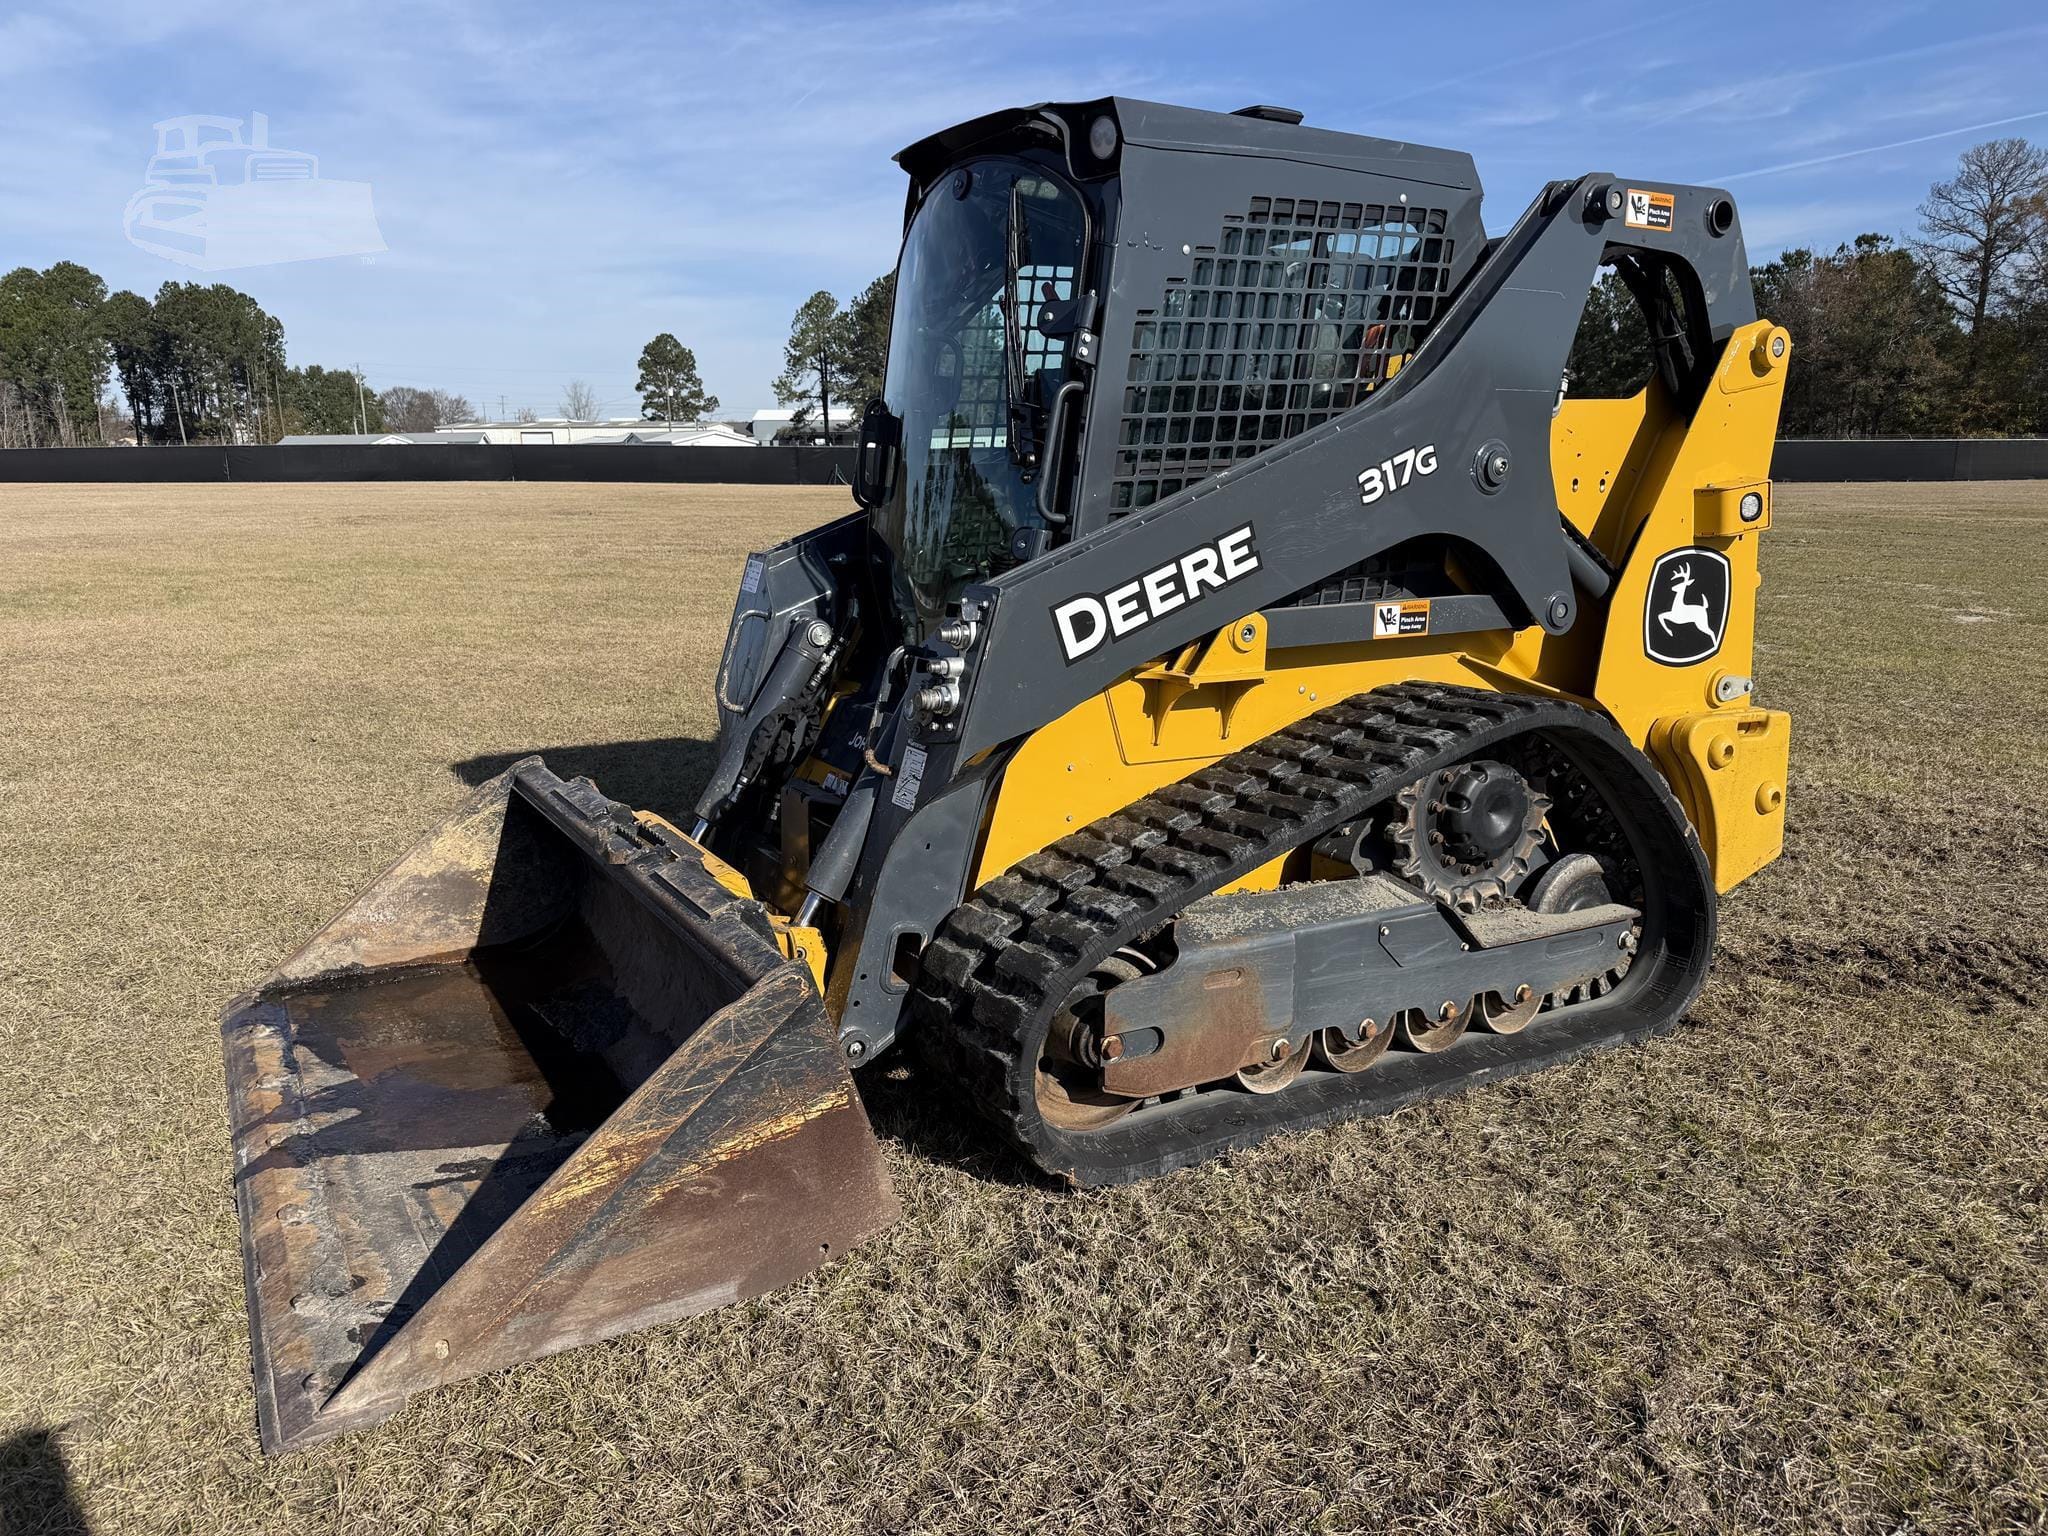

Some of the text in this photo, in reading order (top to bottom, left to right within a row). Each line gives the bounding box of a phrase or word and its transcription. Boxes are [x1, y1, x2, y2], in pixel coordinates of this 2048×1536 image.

[1357, 445, 1438, 504] 317G
[1055, 526, 1260, 660] DEERE
[848, 731, 866, 751] JOH
